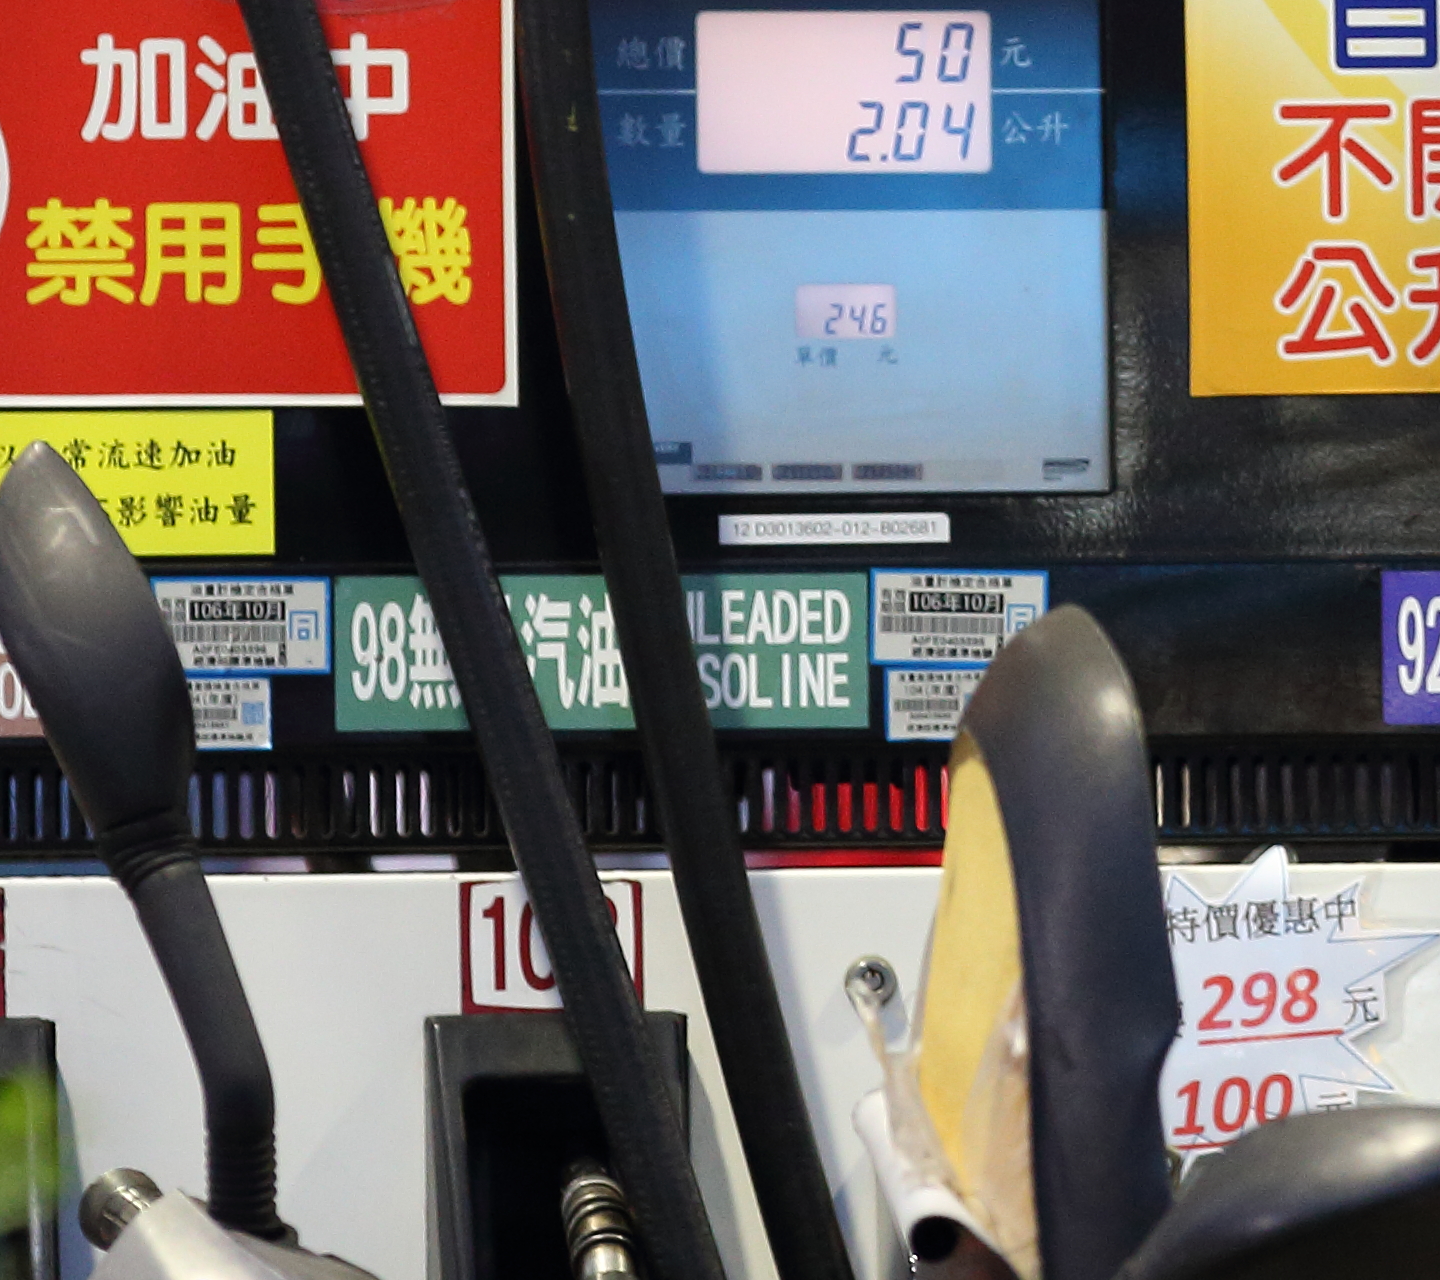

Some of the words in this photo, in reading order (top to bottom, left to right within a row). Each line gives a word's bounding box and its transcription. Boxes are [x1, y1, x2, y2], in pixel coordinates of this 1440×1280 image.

[895, 23, 975, 84] 50
[1001, 37, 1033, 69] 元
[79, 33, 410, 143] 加油中
[847, 101, 976, 162] 2.04
[1002, 117, 1069, 146] 公升
[687, 589, 851, 646] LEADED
[351, 594, 629, 709] 98無汽油
[700, 653, 851, 709] SOLINE
[482, 895, 618, 991] 10
[1167, 893, 1357, 945] 特價優惠中
[1197, 968, 1320, 1032] 298
[1343, 986, 1379, 1026] 元
[1173, 1073, 1294, 1136] 100
